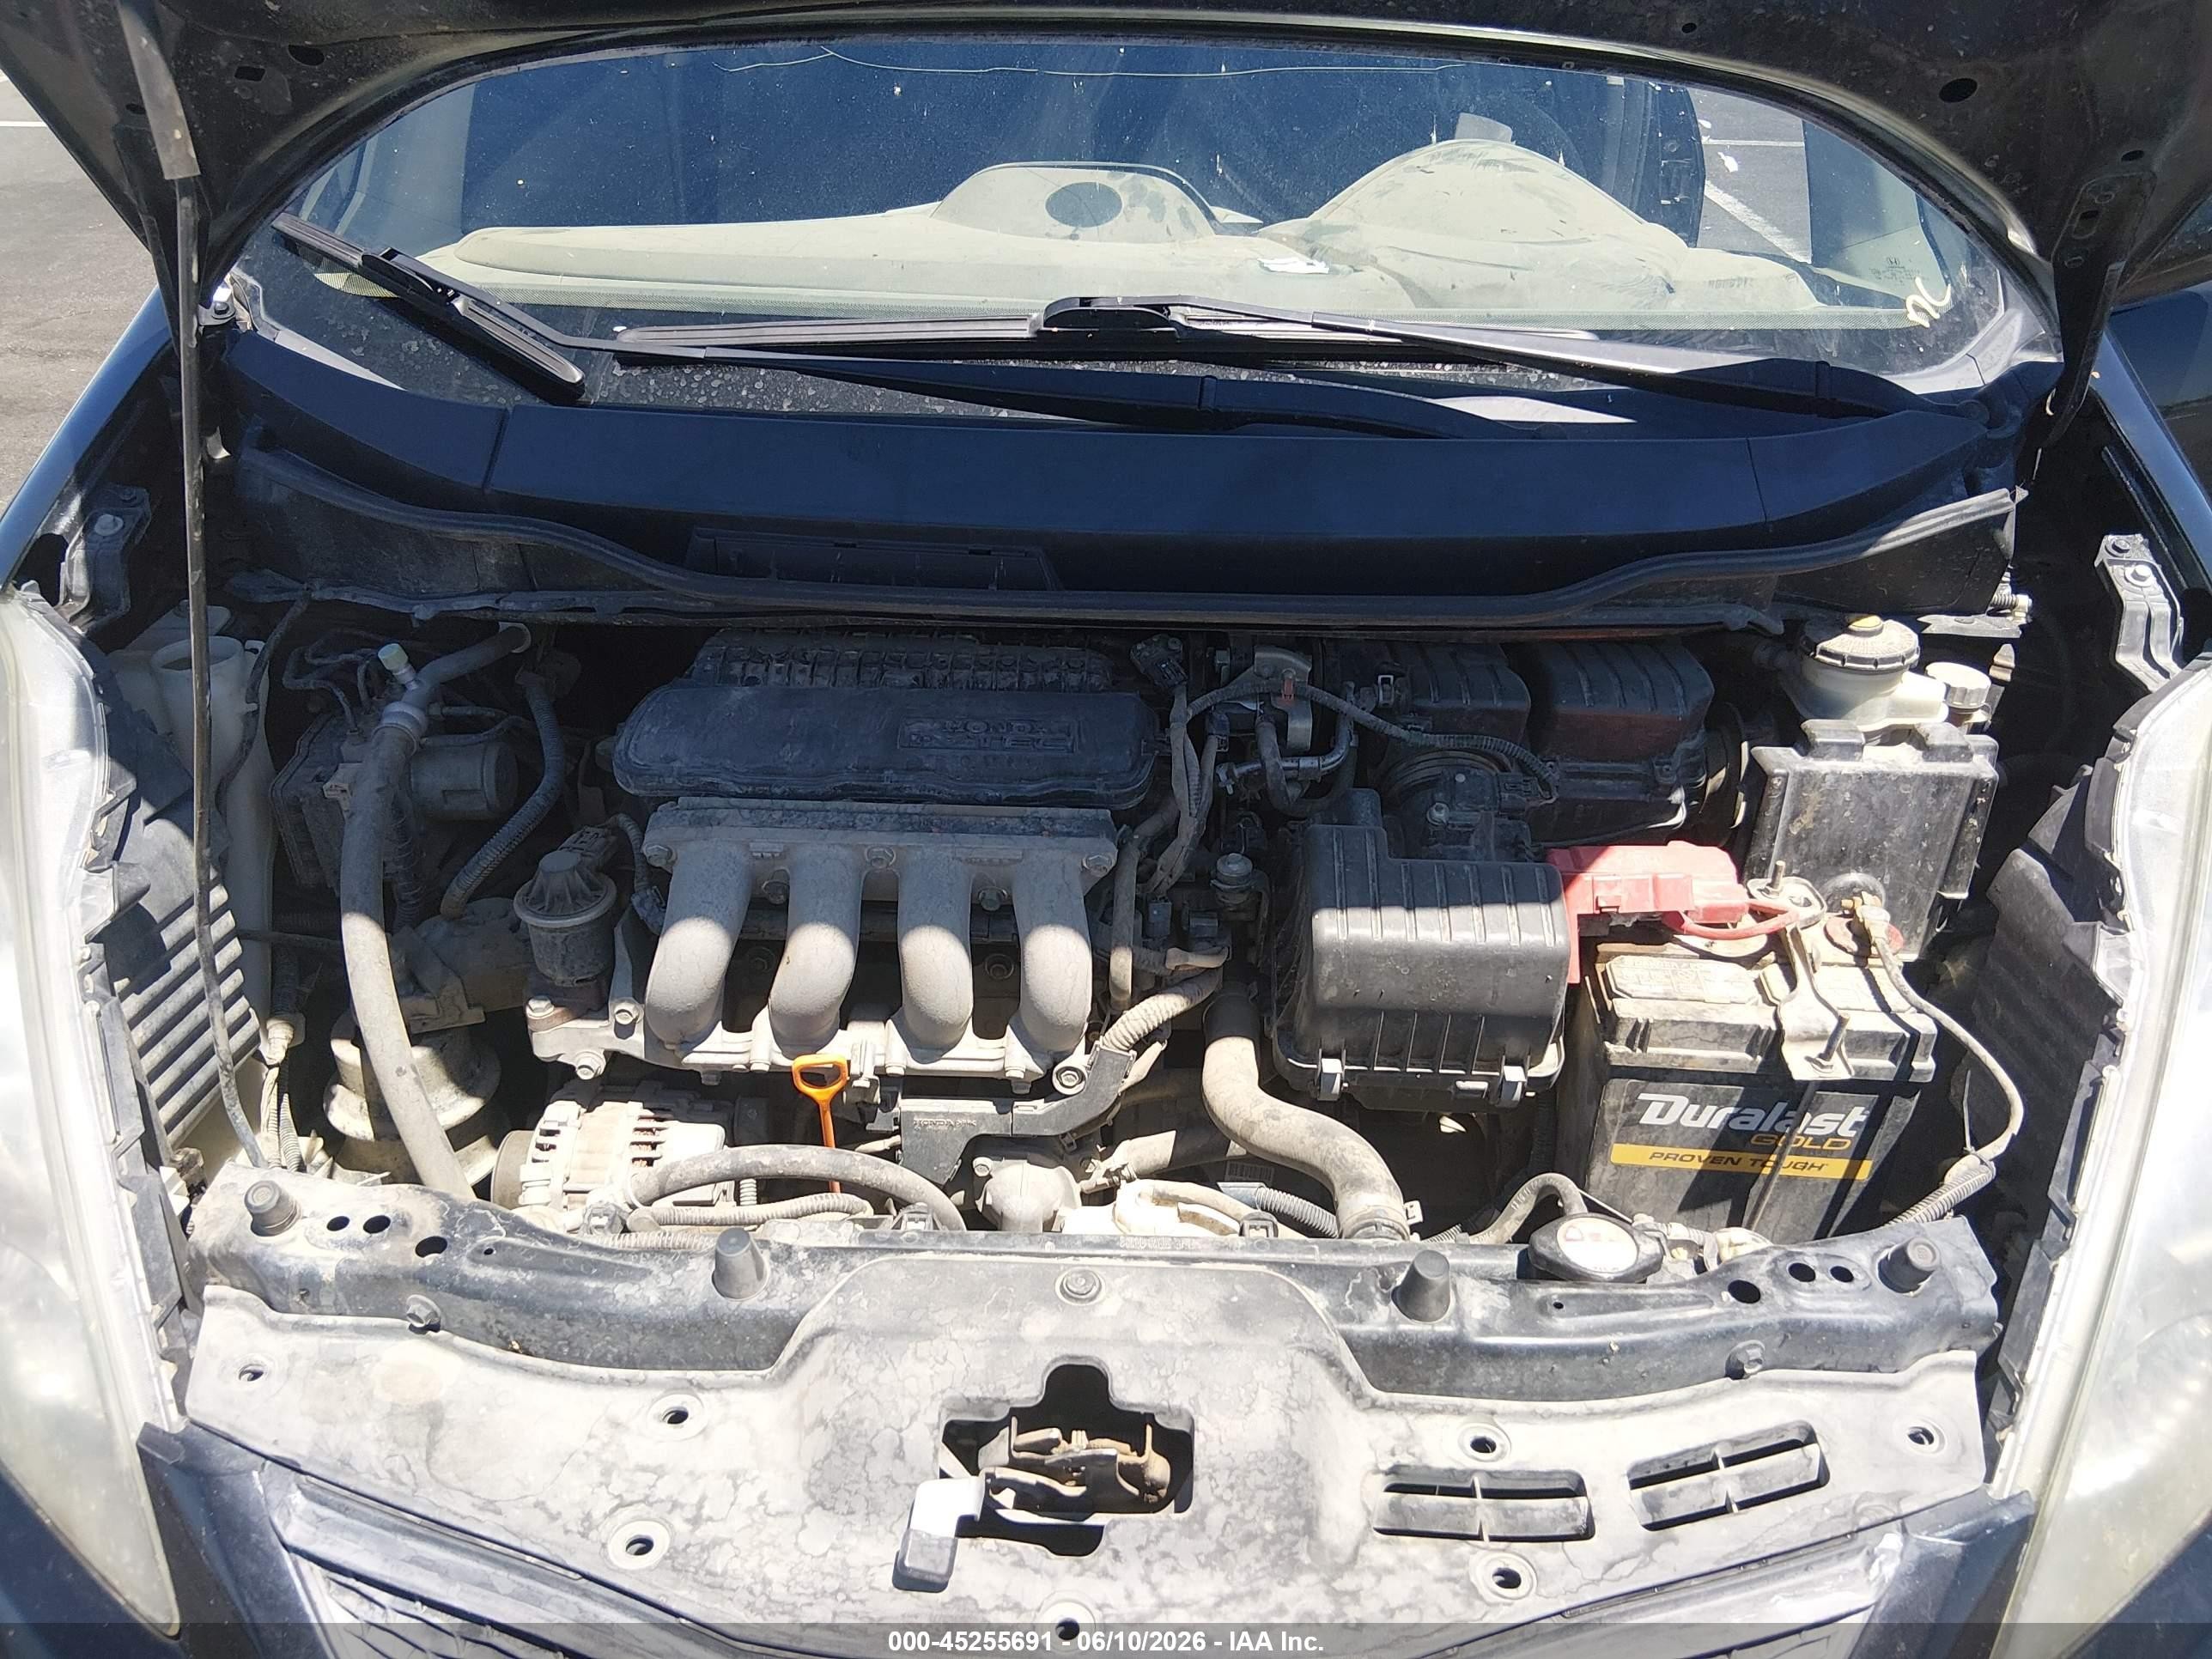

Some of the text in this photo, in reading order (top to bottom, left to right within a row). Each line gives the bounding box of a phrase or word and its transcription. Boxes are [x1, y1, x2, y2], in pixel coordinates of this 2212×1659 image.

[1637, 1092, 1870, 1137] Duralast
[1750, 1133, 1851, 1151] GOLD
[1648, 1151, 1824, 1172] PROVEN TOUGH
